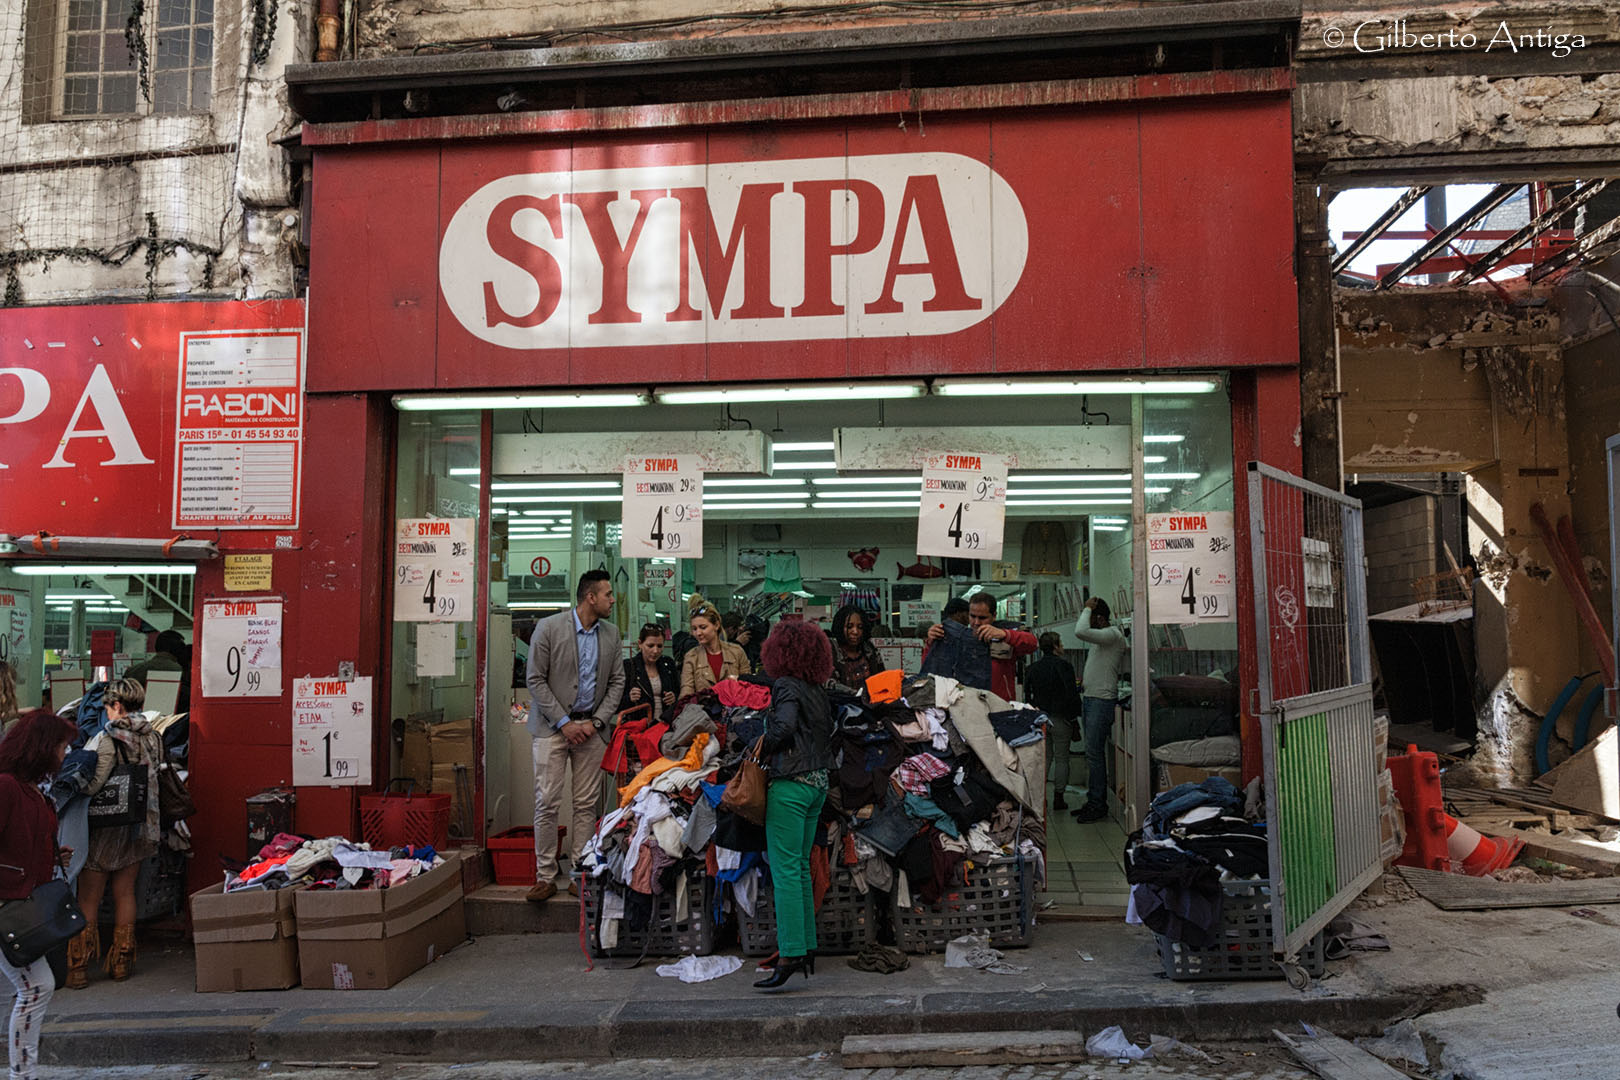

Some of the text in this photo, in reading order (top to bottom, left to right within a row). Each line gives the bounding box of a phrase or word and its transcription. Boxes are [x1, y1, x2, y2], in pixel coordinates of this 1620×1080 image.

[483, 174, 983, 328] SYMPA
[184, 393, 296, 416] RABONI
[178, 431, 204, 439] PARIS
[231, 430, 242, 439] 01
[245, 430, 256, 438] 45
[259, 429, 270, 438] 54
[273, 429, 284, 438] 93
[287, 429, 299, 438] 40
[644, 458, 678, 472] SYMPA
[946, 455, 982, 470] SYMPA
[418, 523, 450, 535] SYMPA
[1170, 516, 1207, 530] SYMPA
[667, 533, 680, 549] 99
[965, 532, 979, 549] 99
[224, 602, 257, 616] SYMPA
[439, 597, 455, 616] 99
[1202, 595, 1218, 614] 99
[247, 671, 260, 691] 99
[314, 682, 347, 695] SYMPA
[299, 713, 322, 721] ETAM
[336, 760, 348, 777] 99
